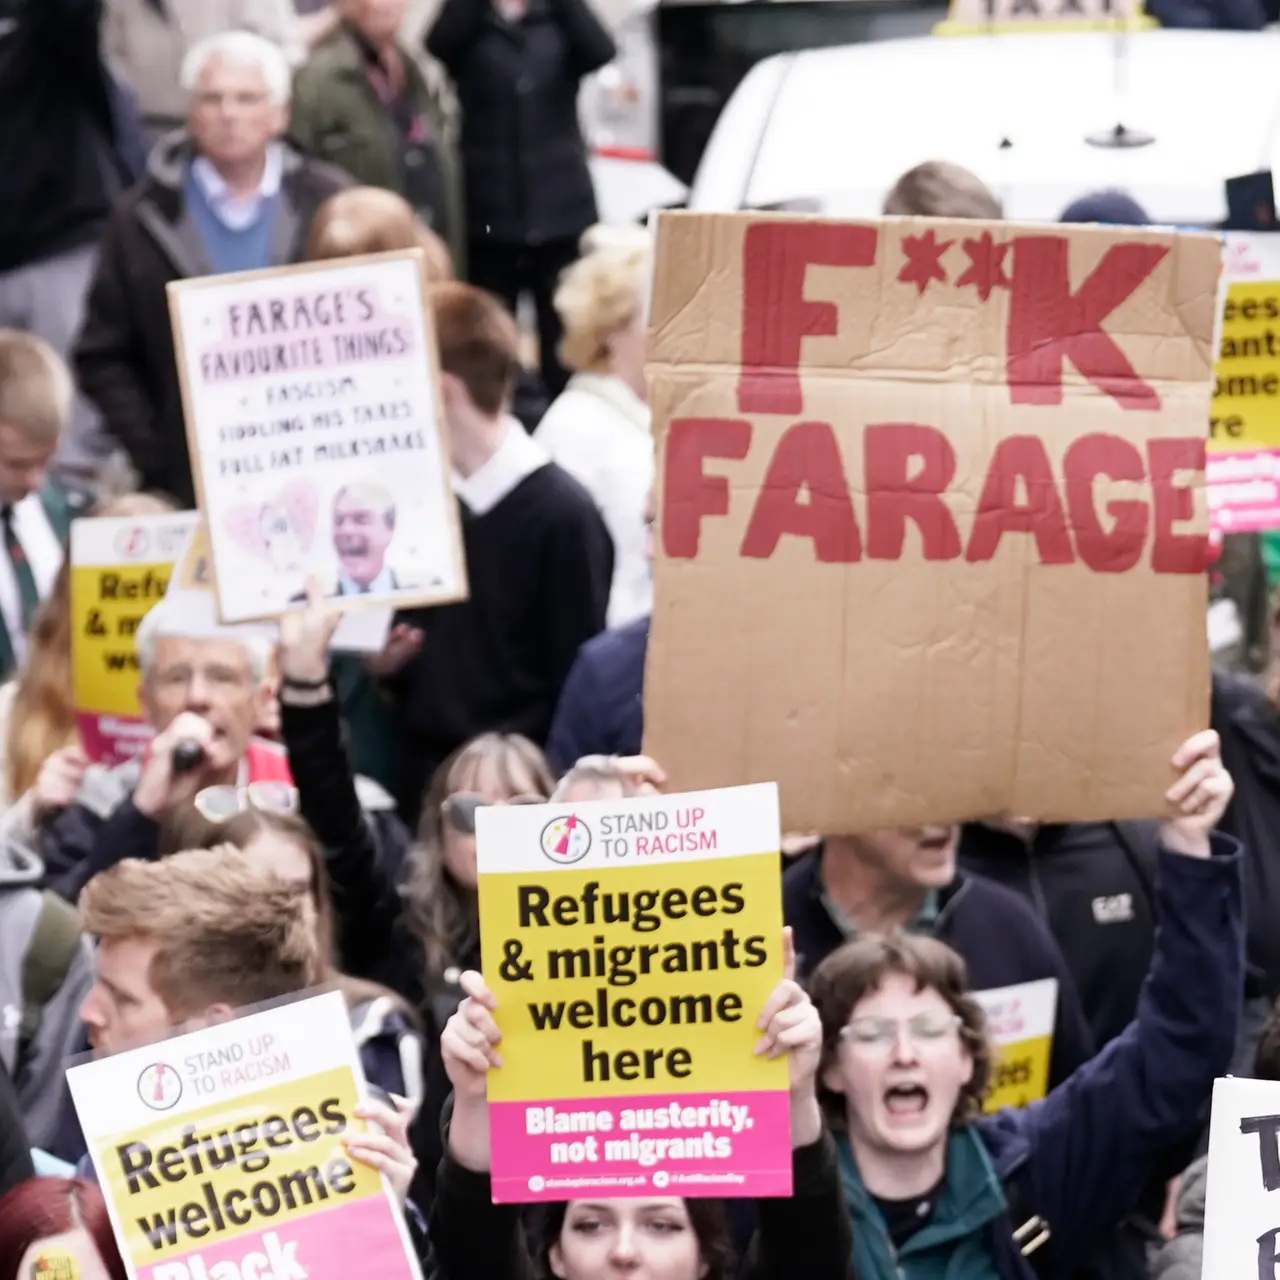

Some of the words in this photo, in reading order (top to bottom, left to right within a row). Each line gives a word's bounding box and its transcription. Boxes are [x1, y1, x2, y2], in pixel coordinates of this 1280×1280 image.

[229, 290, 376, 338] FARAGE'S
[200, 338, 325, 382] FAVOURITE
[333, 327, 408, 363] THINGS
[266, 376, 358, 405] FASCISM
[312, 409, 344, 429] HIS
[220, 457, 265, 478] FULL
[270, 446, 304, 468] FAT
[662, 418, 1208, 574] FARAGE
[85, 608, 107, 637] &
[600, 810, 668, 836] STAND
[675, 807, 705, 829] UP
[601, 838, 629, 859] TO
[636, 829, 718, 857] RACISM
[518, 881, 745, 932] Refugees
[498, 938, 534, 983] &
[548, 929, 768, 987] migrants
[527, 987, 743, 1031] welcome
[184, 1042, 244, 1076] STAND
[249, 1033, 276, 1057] UP
[190, 1075, 216, 1097] TO
[220, 1052, 292, 1088] RACISM
[581, 1039, 692, 1082] here
[525, 1106, 613, 1135] Blame
[619, 1098, 755, 1133] austerity,
[115, 1097, 348, 1195] Refugees
[550, 1135, 598, 1164] not
[604, 1131, 732, 1167] migrants
[136, 1157, 357, 1251] welcome
